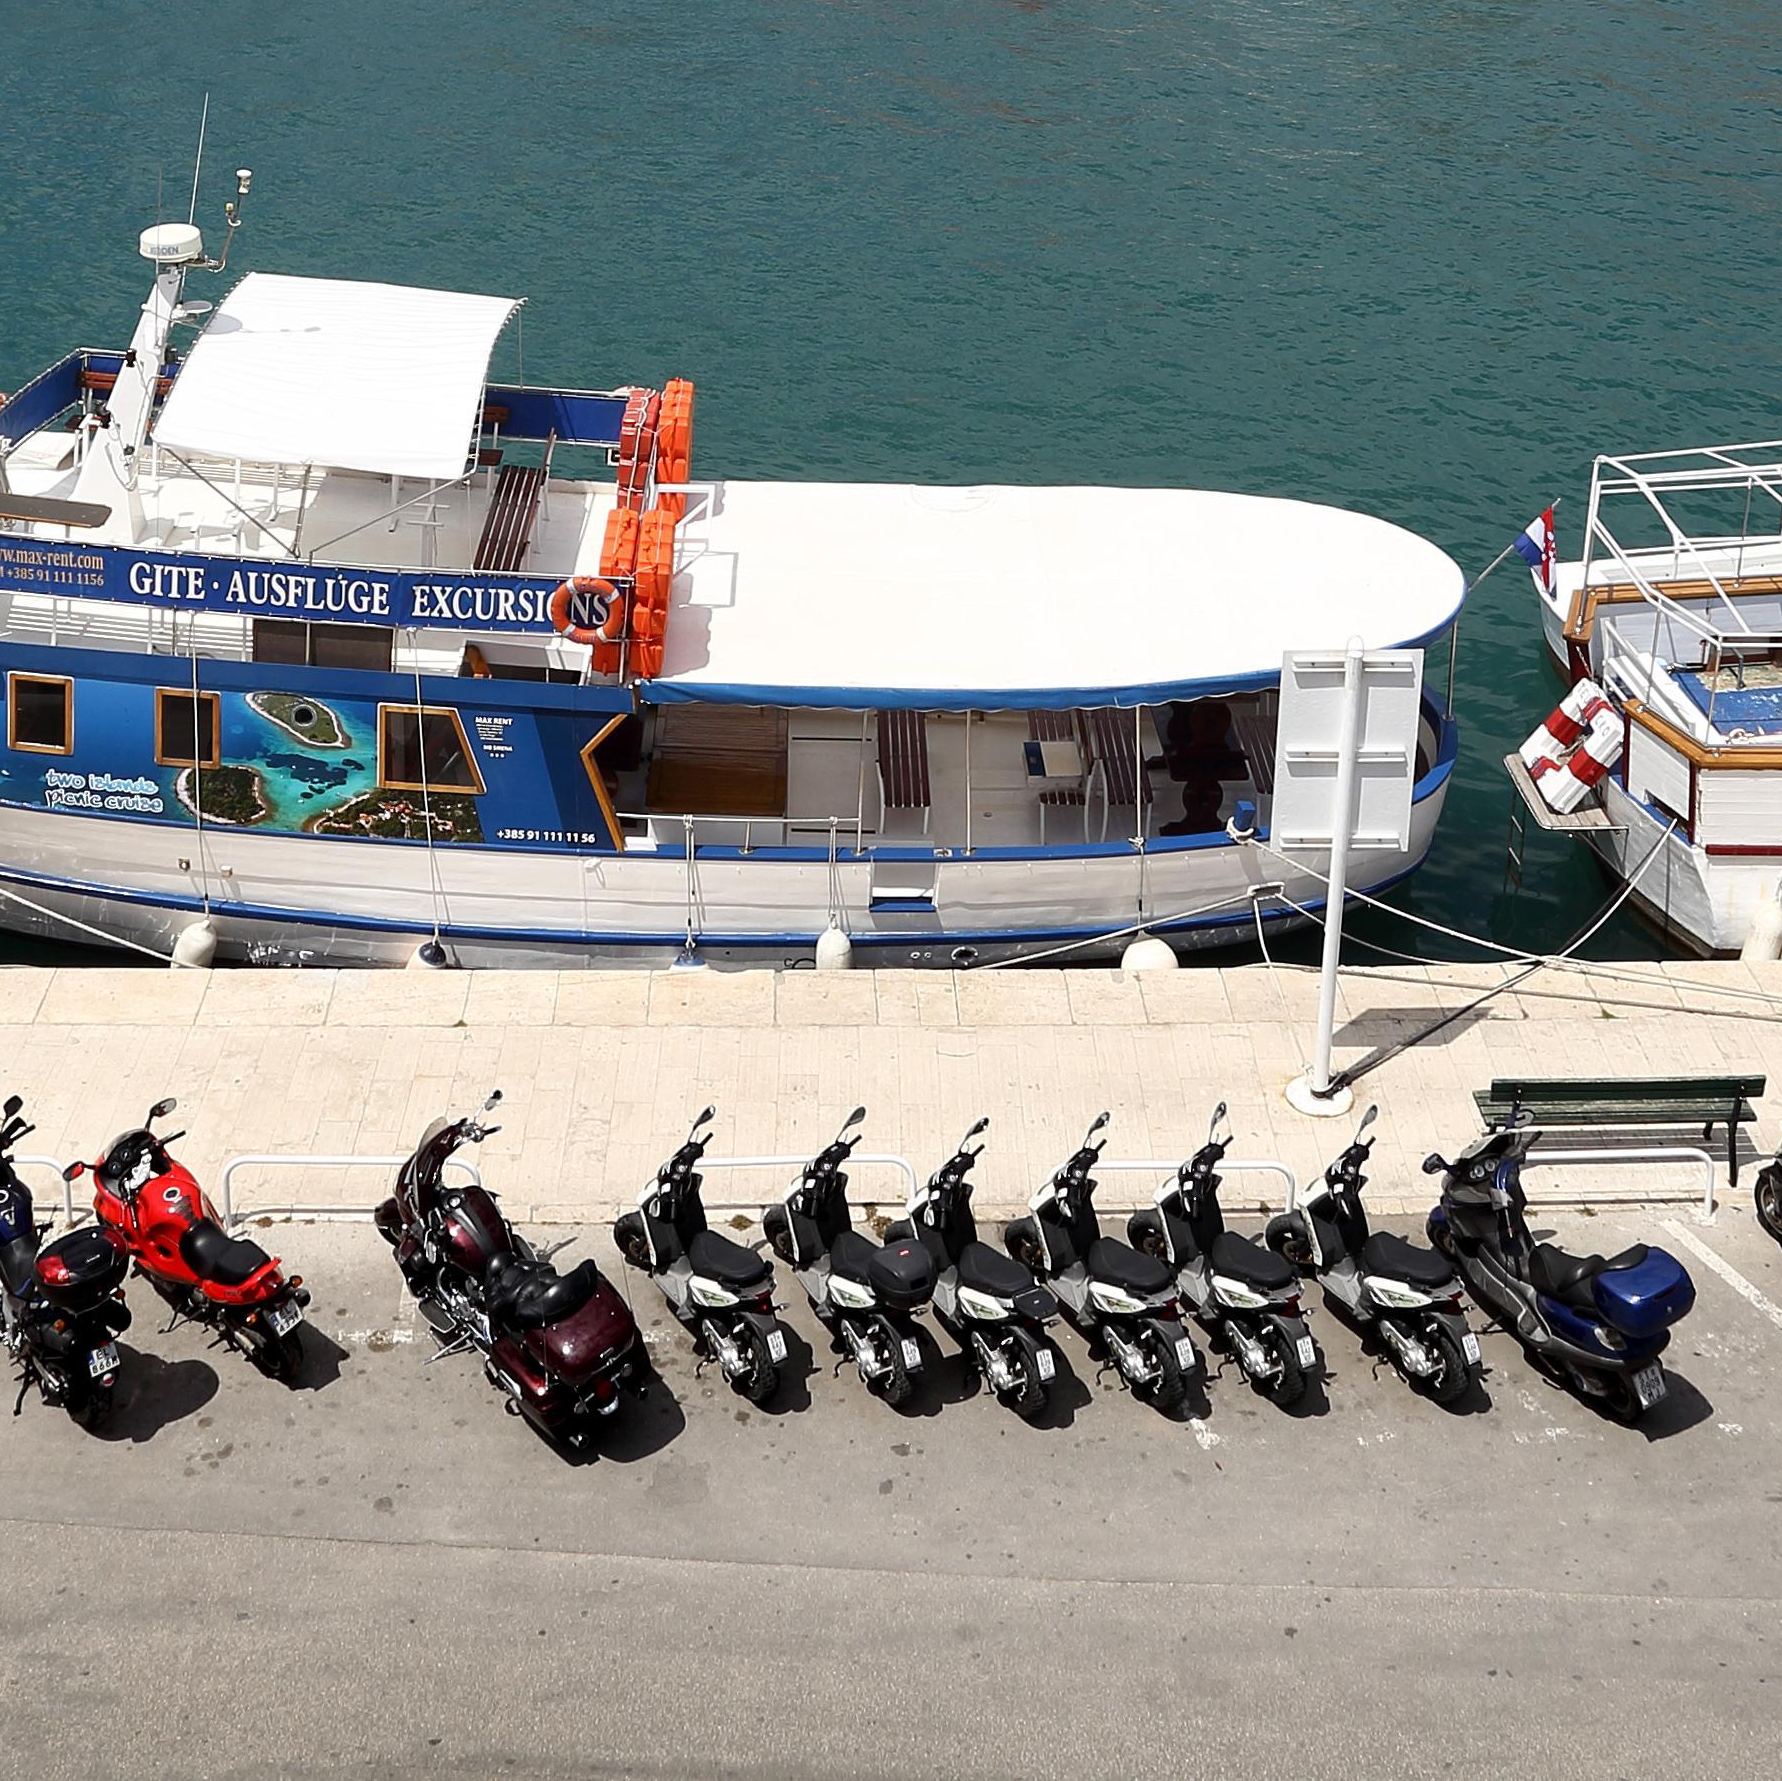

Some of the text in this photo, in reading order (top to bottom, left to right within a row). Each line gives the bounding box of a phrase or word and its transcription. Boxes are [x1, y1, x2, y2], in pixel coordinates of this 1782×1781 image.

[7, 567, 35, 581] +385
[37, 570, 51, 583] 91
[53, 571, 74, 585] 111
[76, 572, 105, 587] 1156
[129, 561, 206, 600] GITE
[411, 584, 609, 626] EXCURSINS
[46, 768, 159, 795] two islands
[45, 789, 164, 814] picnic cruise
[497, 828, 596, 844] +385 91 111 11 56
